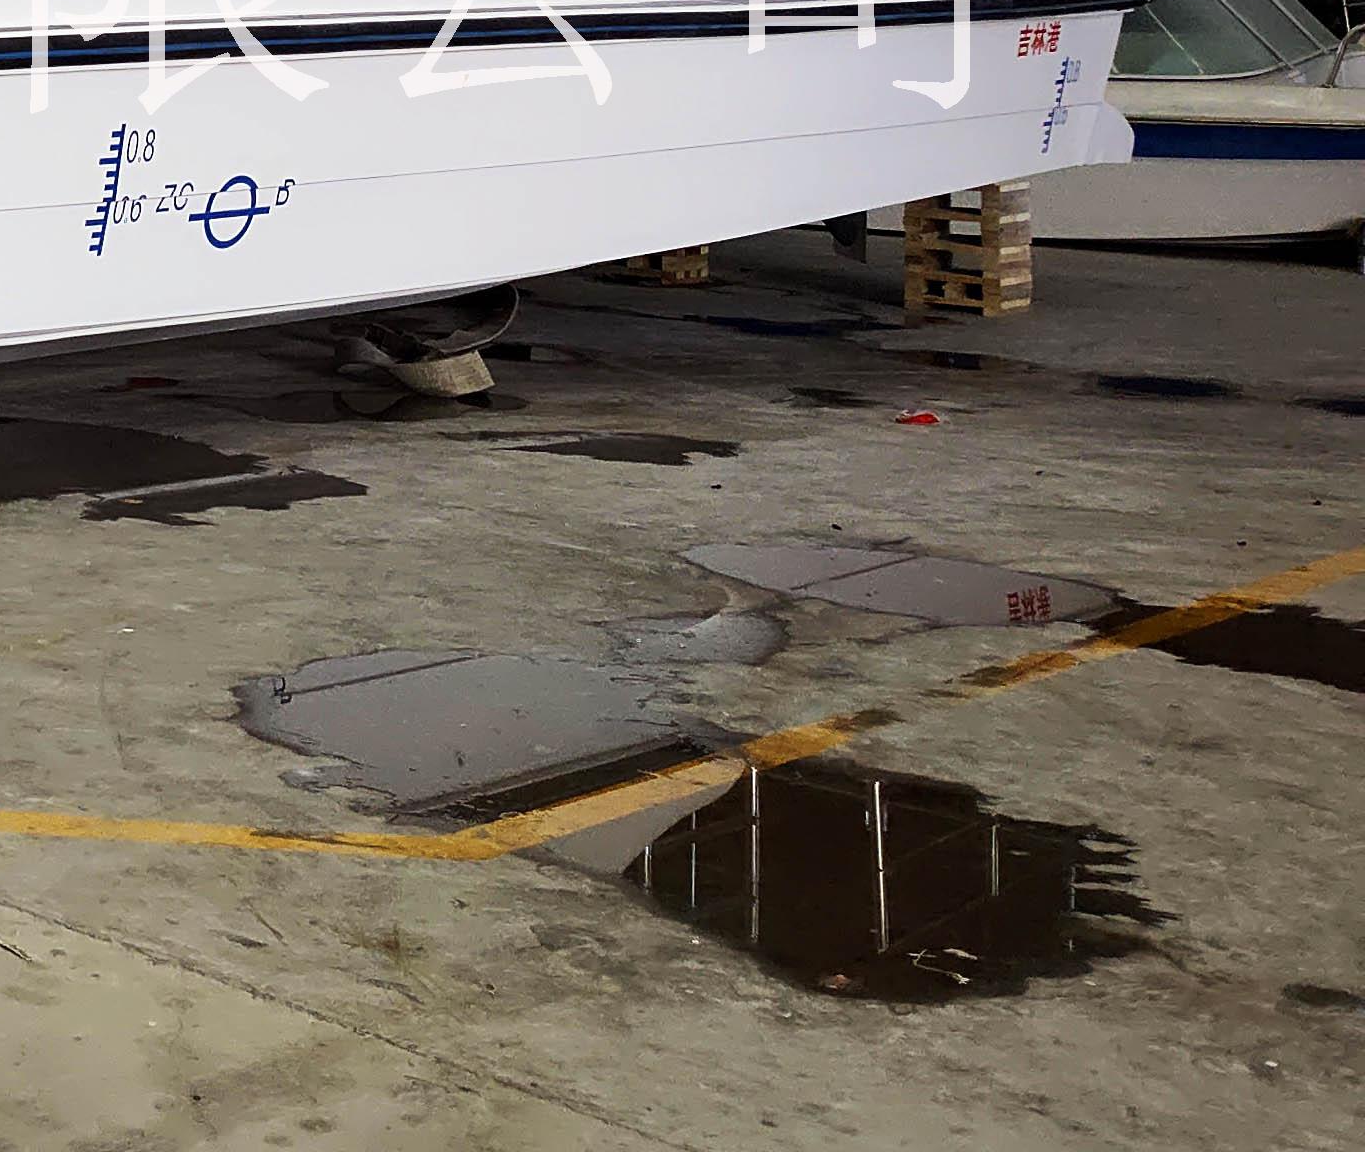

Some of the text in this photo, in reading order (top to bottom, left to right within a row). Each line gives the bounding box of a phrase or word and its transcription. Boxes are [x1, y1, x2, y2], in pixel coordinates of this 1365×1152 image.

[1017, 21, 1062, 57] 吉林港
[126, 129, 156, 163] 0.8
[113, 194, 147, 224] 0.6
